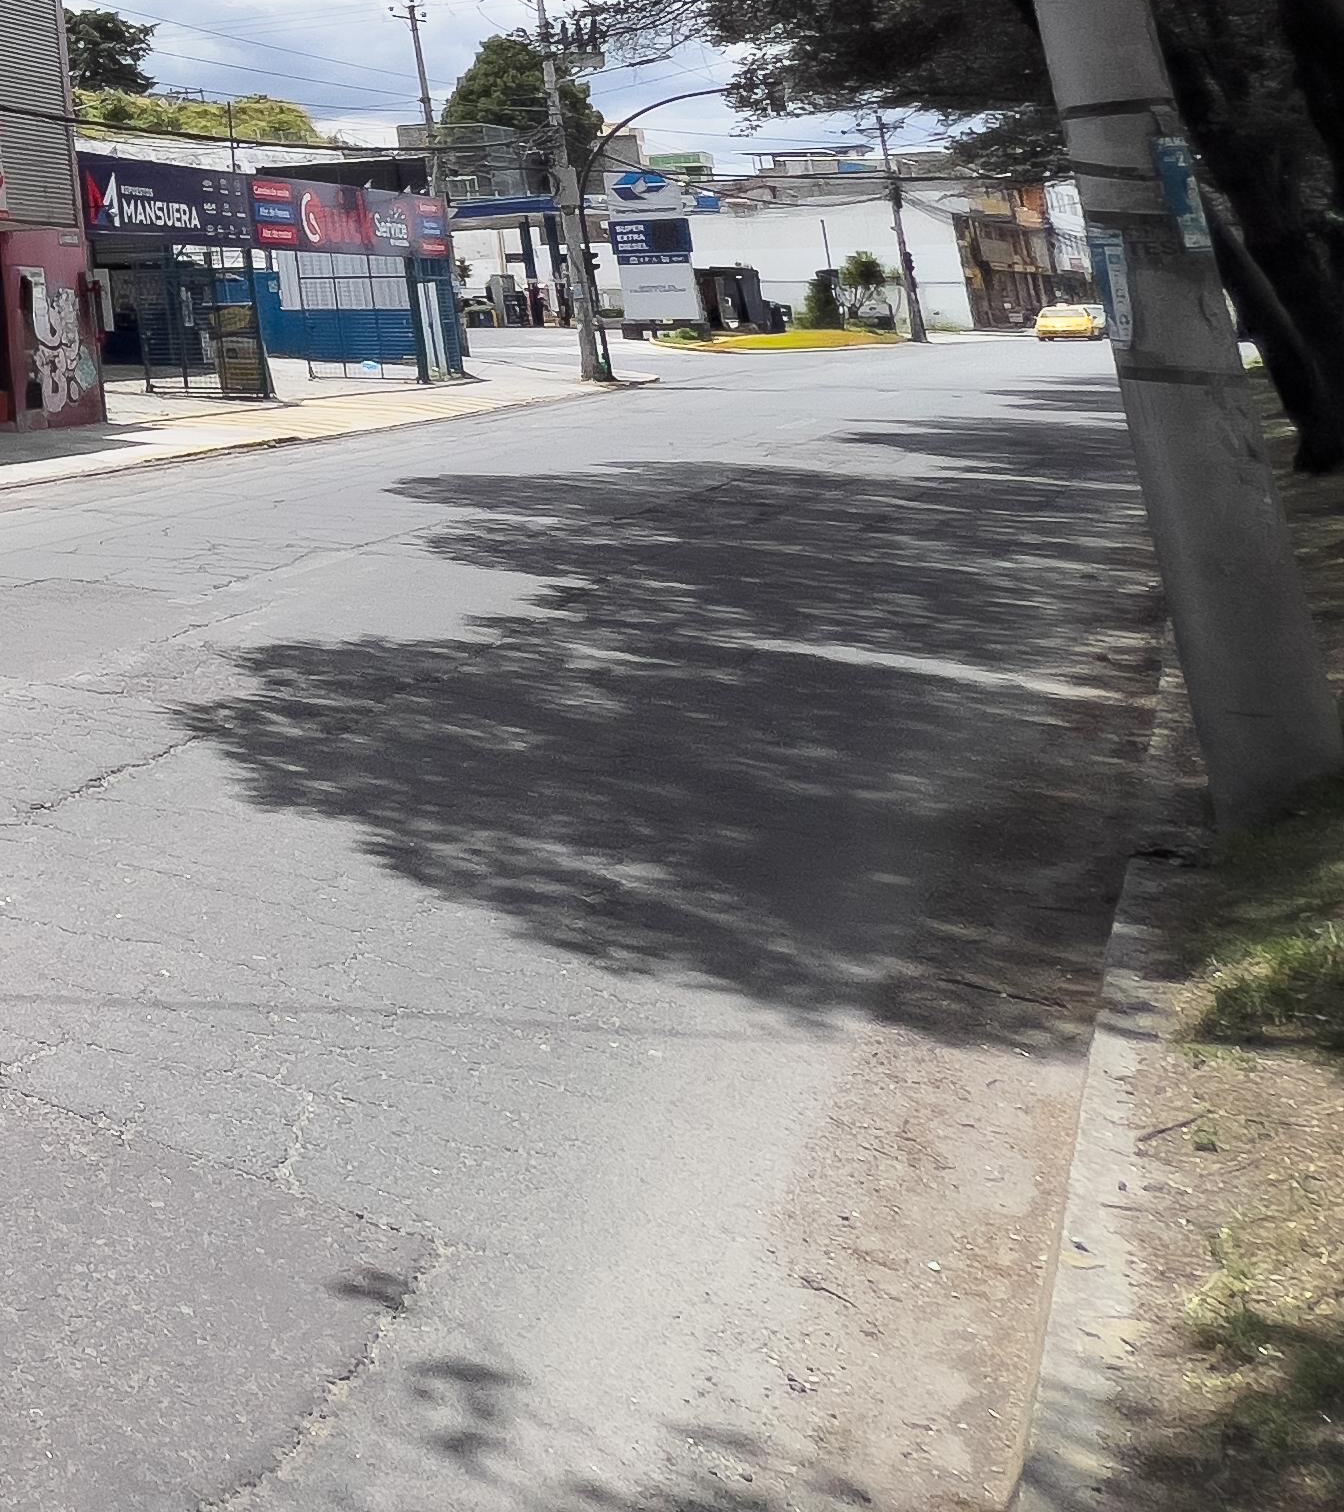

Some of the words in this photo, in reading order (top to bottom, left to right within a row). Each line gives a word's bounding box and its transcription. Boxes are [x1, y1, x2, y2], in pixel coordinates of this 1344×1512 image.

[122, 198, 201, 229] MANSUERA
[615, 224, 645, 233] SUPER
[616, 233, 646, 242] EXTRA
